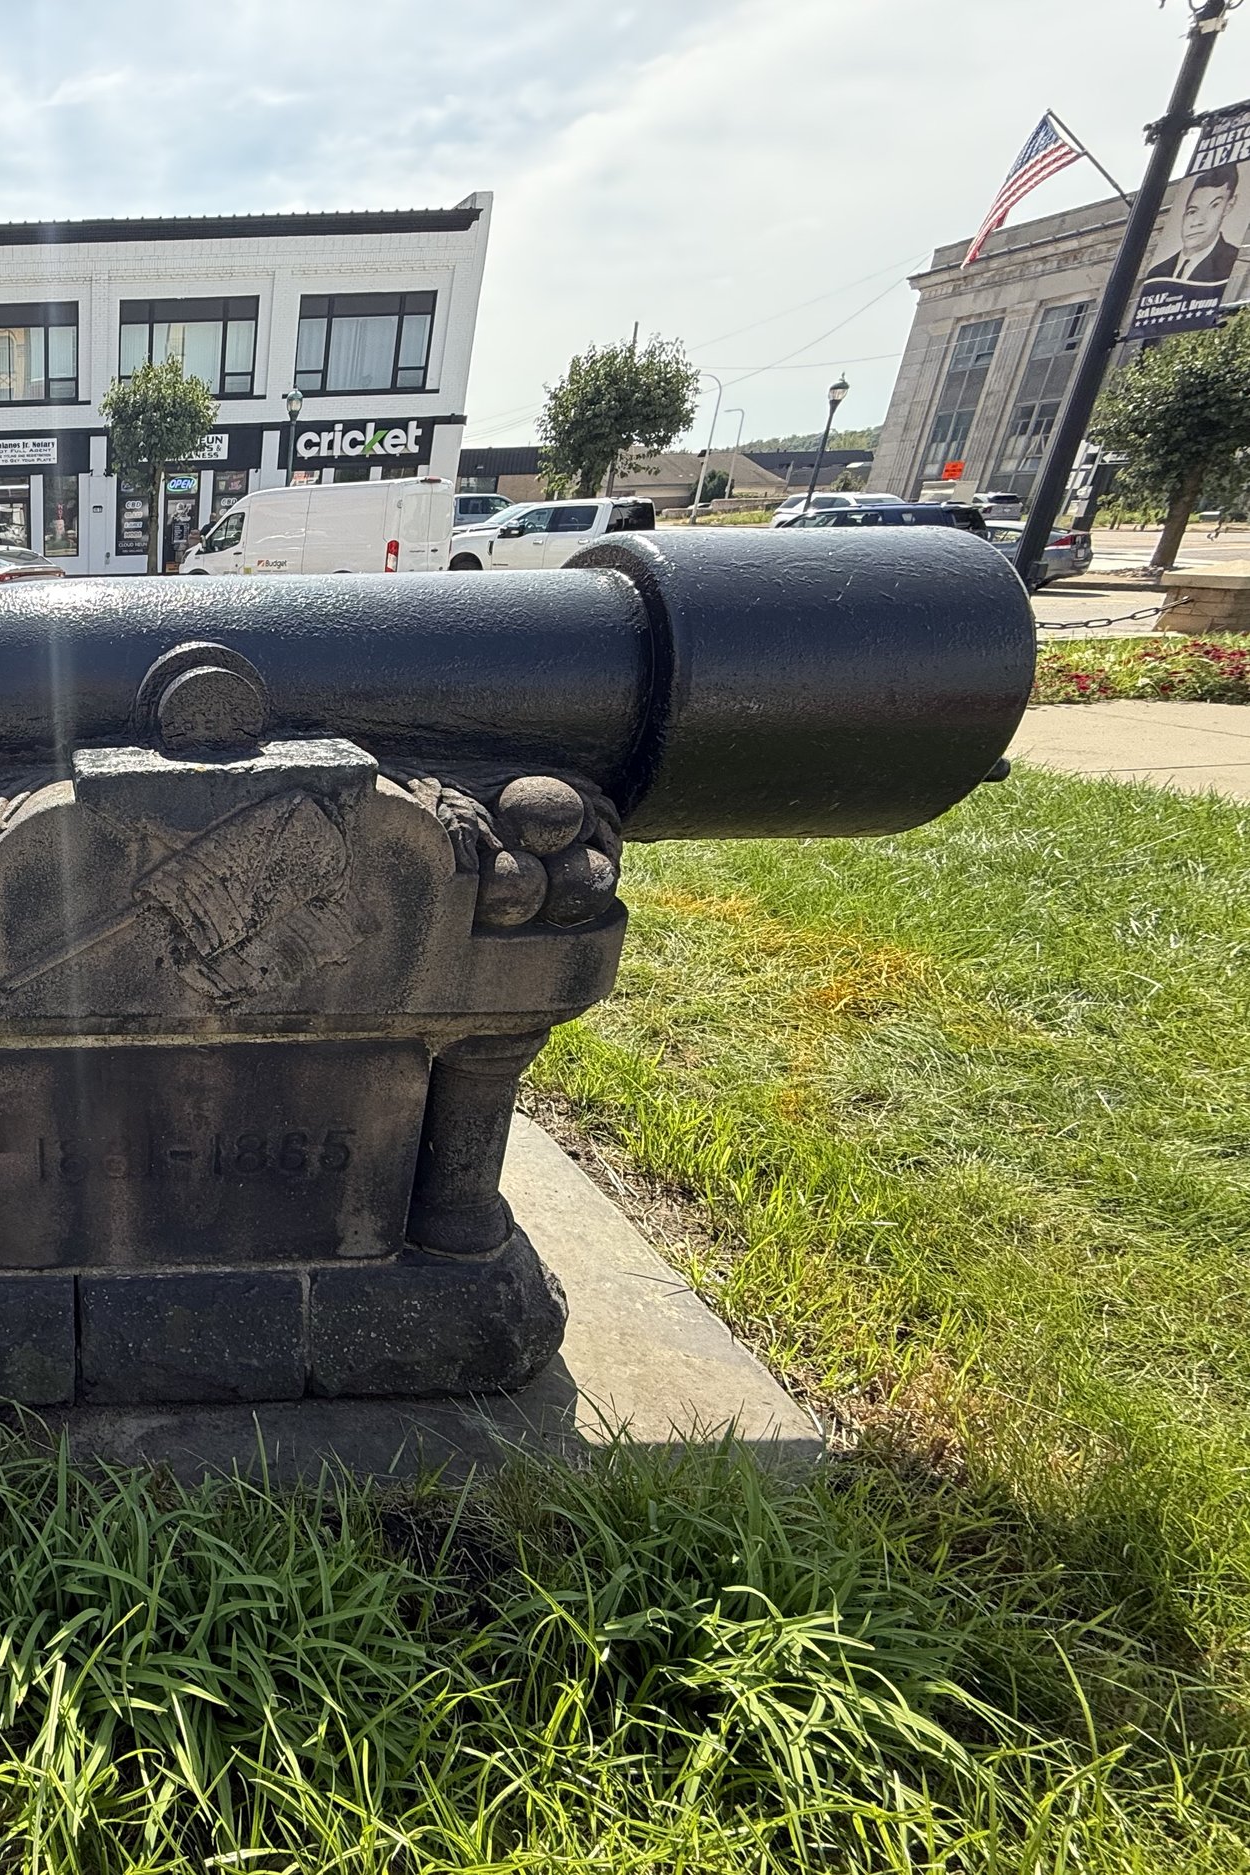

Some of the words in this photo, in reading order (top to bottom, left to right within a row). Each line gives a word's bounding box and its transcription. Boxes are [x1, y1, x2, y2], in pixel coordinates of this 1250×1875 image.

[1140, 292, 1169, 307] USAF
[296, 420, 422, 458] cricket
[169, 479, 194, 490] OPEN
[265, 560, 287, 569] Budget
